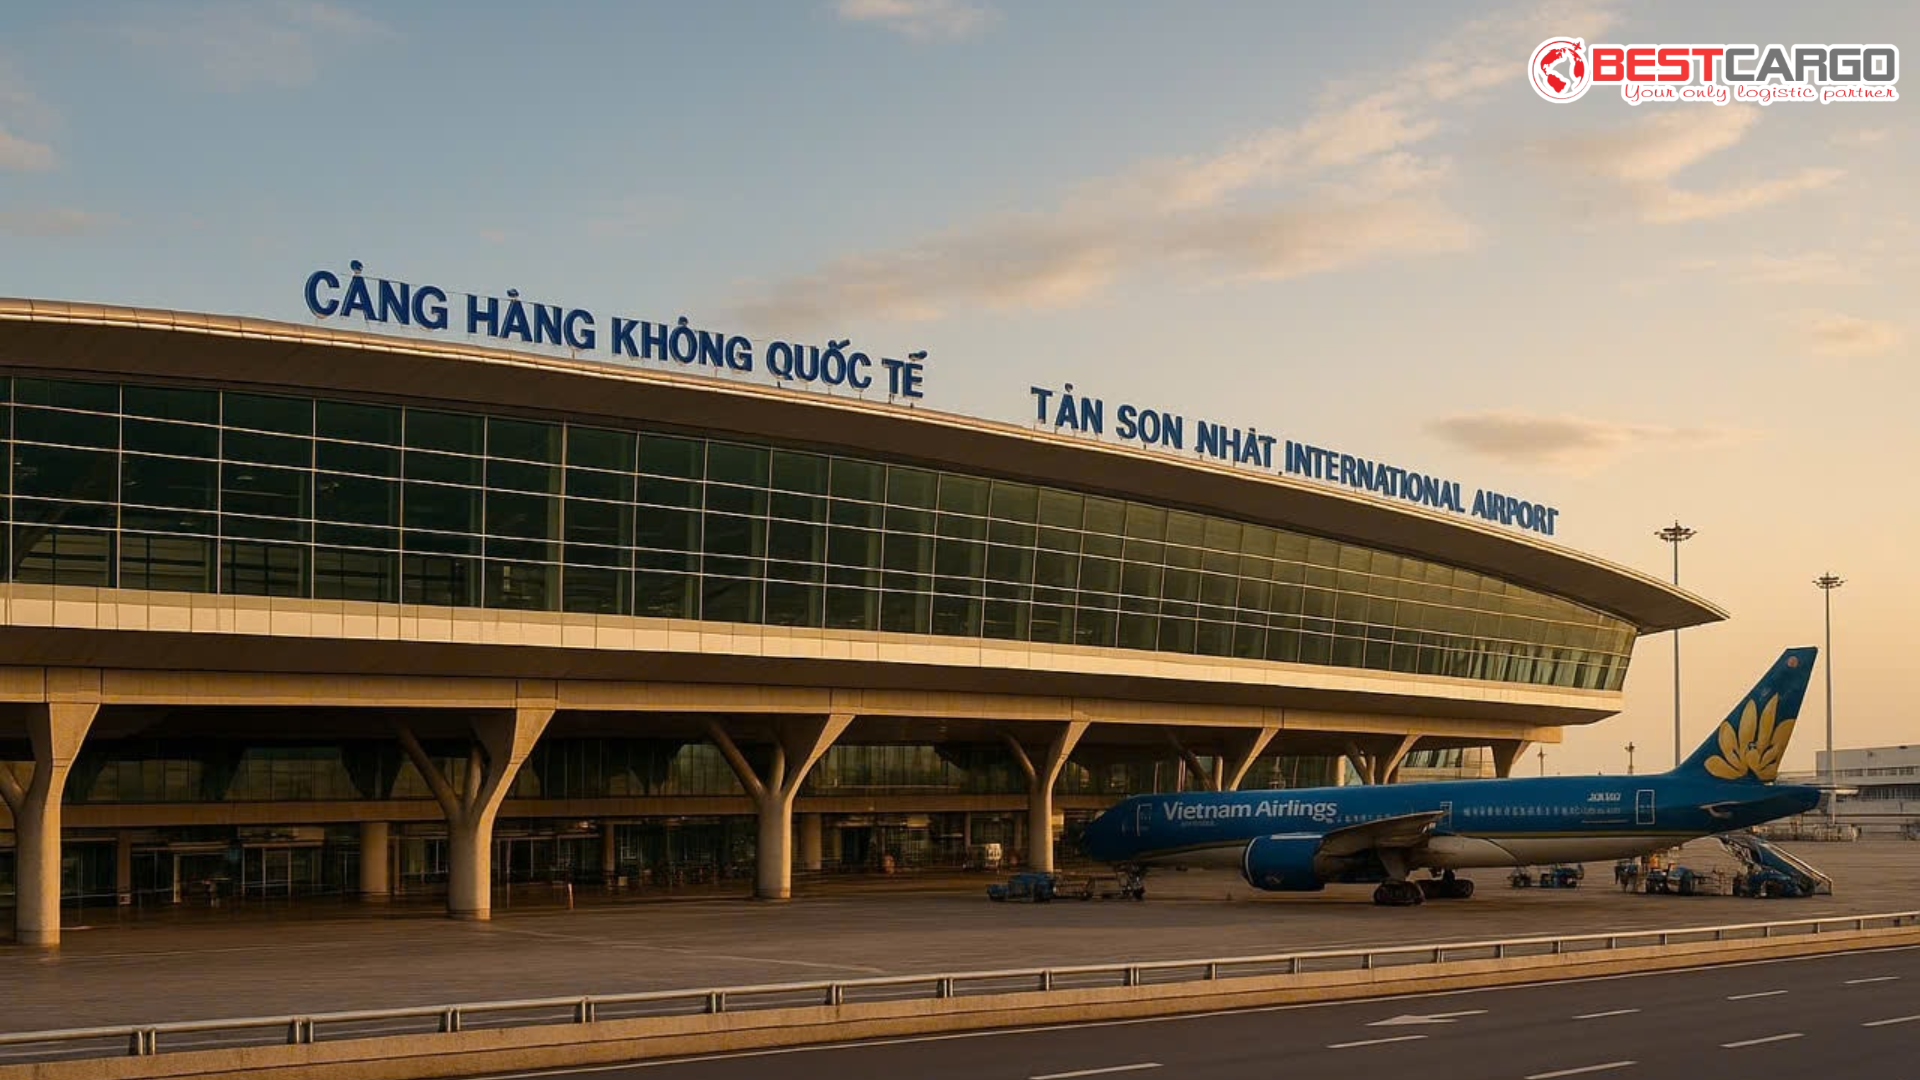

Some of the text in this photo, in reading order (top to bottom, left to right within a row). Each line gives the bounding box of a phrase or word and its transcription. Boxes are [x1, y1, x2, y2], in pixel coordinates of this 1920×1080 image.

[1285, 440, 1466, 513] INTERNATIONAL
[1471, 489, 1560, 535] AIRPORT
[1163, 801, 1252, 821] Vietnam
